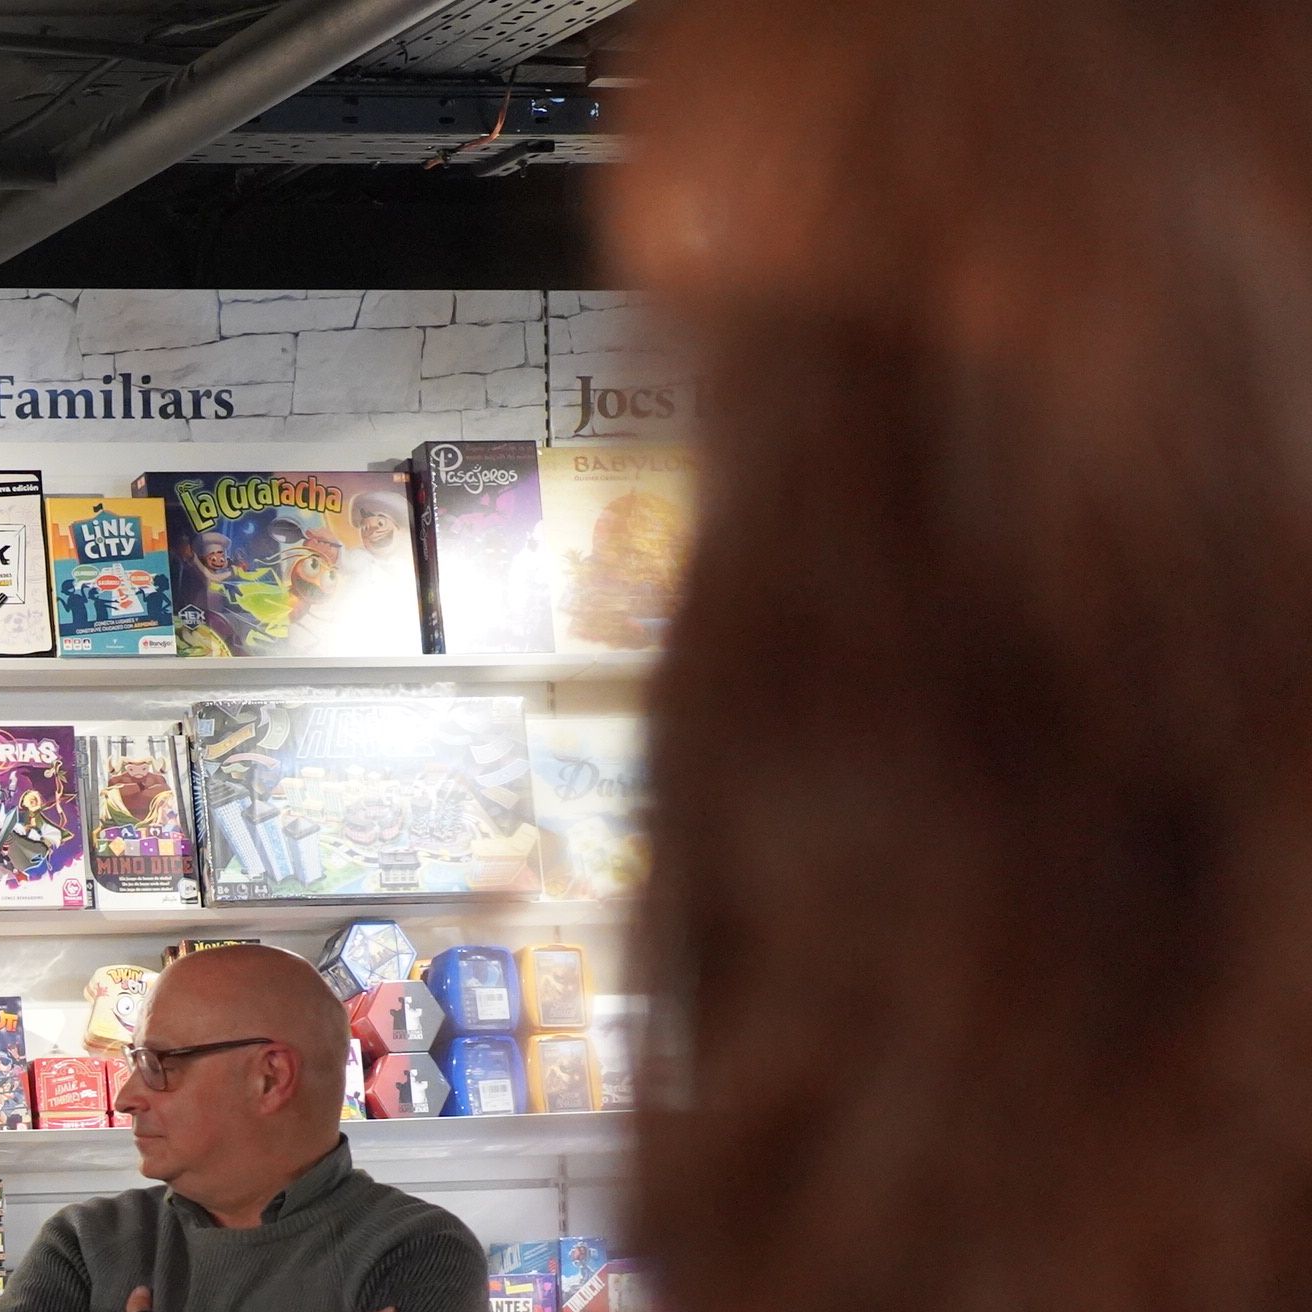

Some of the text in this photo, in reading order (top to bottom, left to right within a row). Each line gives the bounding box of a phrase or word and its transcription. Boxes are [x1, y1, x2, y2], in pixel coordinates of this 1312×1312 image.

[574, 376, 675, 434] Jocs
[430, 443, 518, 494] Pasajeros
[179, 477, 343, 533] La Cucaracha
